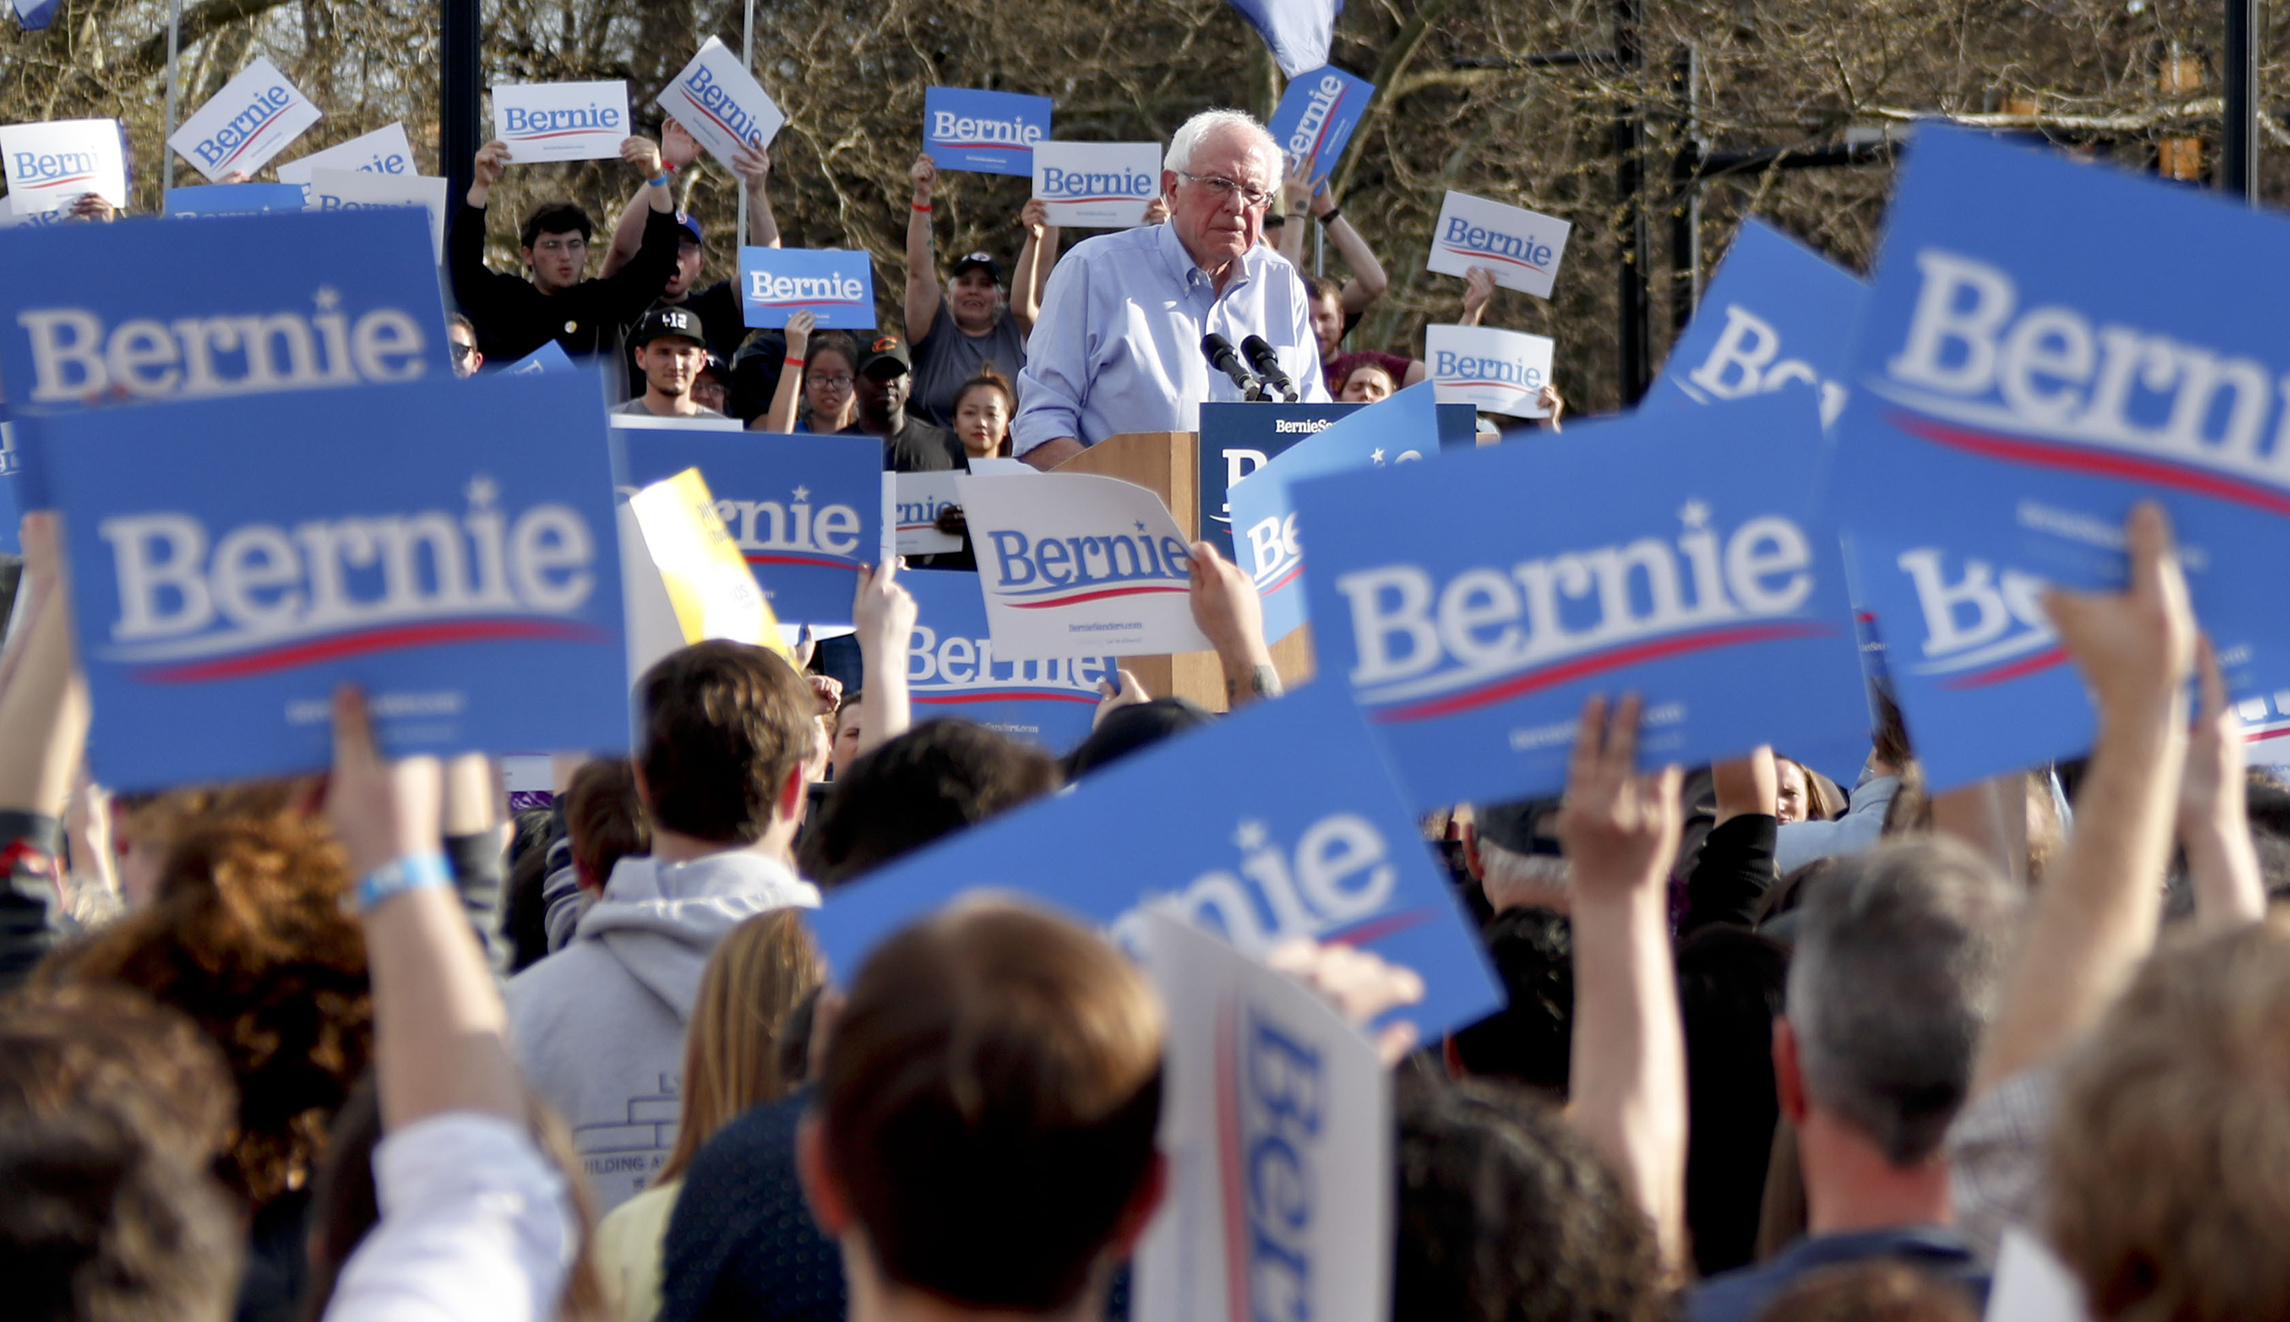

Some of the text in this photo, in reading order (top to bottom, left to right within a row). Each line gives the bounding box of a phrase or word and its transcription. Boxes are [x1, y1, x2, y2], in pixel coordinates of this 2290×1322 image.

[194, 86, 289, 167] Bernie
[504, 102, 619, 132] Bernie
[686, 64, 762, 150] Bernie
[933, 112, 1042, 147] Bernie
[1284, 76, 1342, 173] ernie
[1041, 166, 1152, 196] Bernie
[1444, 217, 1552, 267] Bernie
[749, 270, 863, 301] Bernie
[16, 285, 428, 402] Bernie
[1434, 350, 1541, 388] Bernie
[99, 477, 597, 642] Bernie
[987, 519, 1193, 588] Bernie
[1336, 498, 1813, 686] Bernie
[1110, 814, 1396, 962] nie
